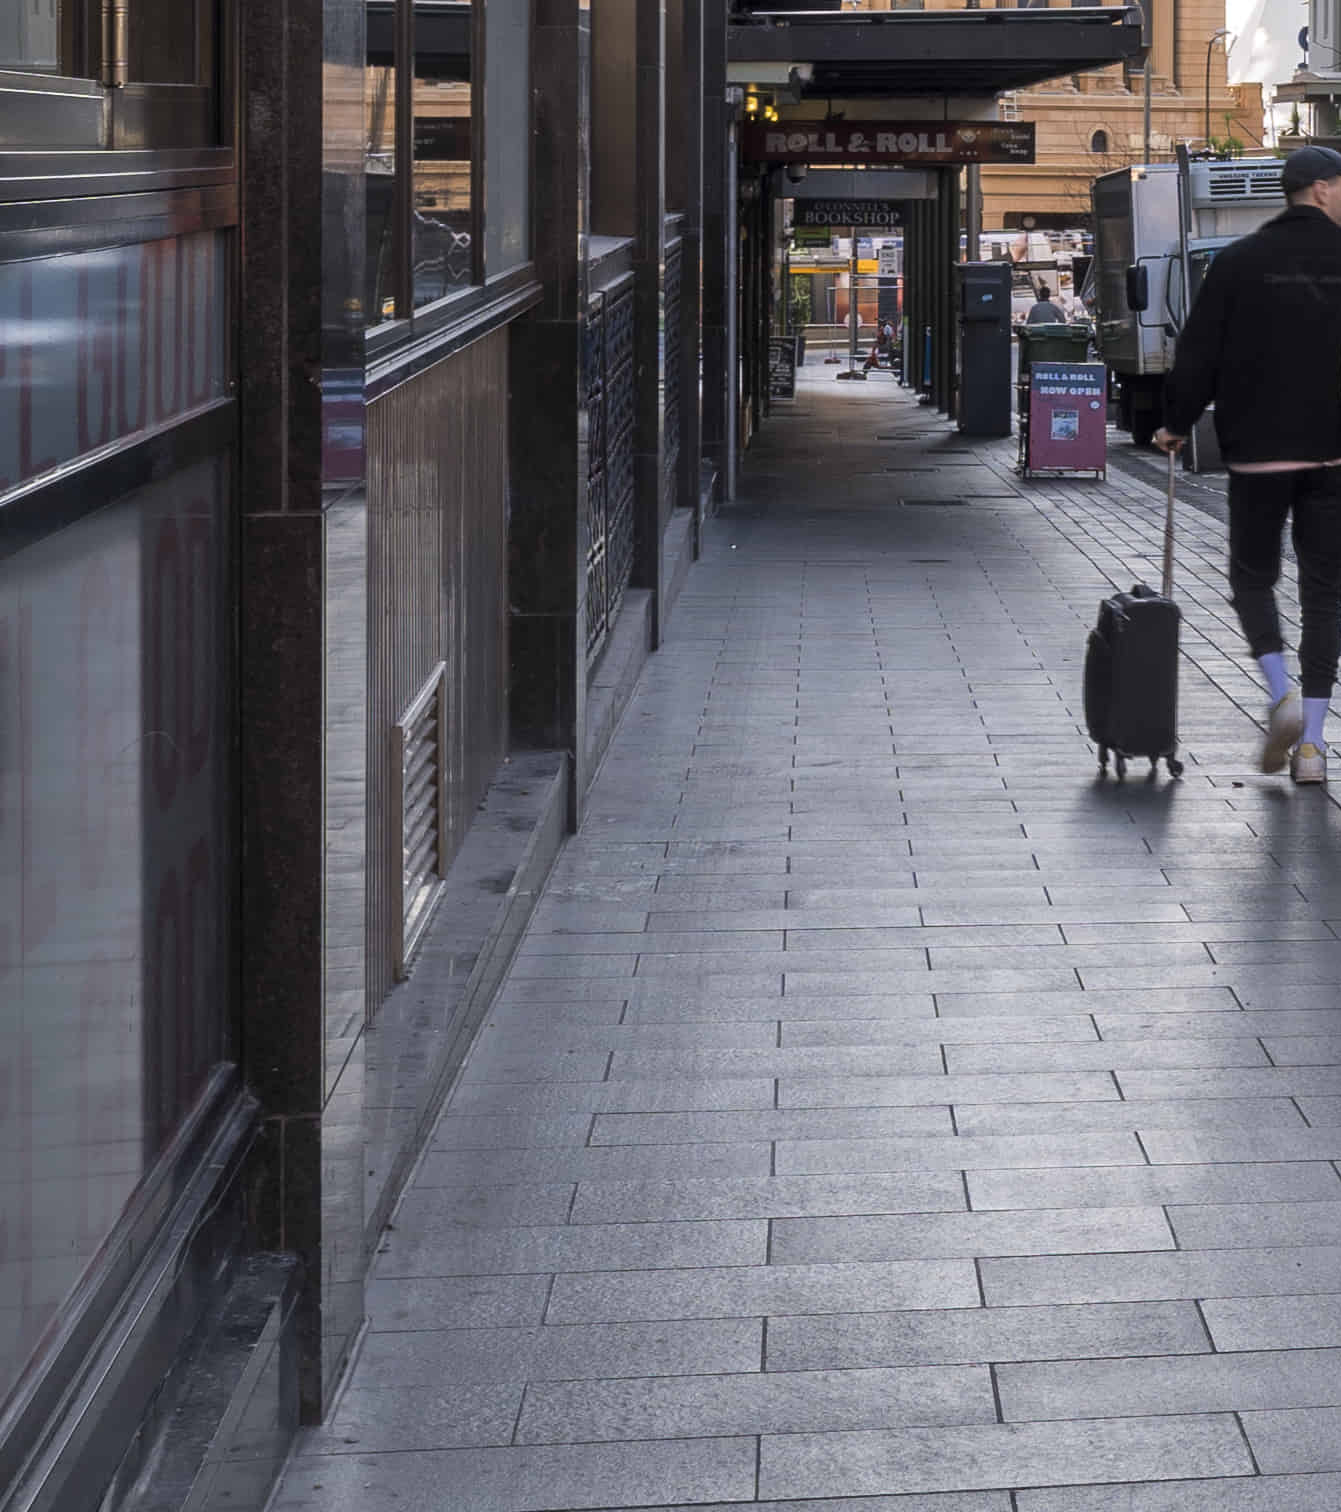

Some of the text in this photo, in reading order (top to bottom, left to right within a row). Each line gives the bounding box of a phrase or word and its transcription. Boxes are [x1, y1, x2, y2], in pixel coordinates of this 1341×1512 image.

[766, 132, 952, 153] ROLL & ROLL
[805, 212, 900, 225] BOOKSHOP
[1040, 386, 1101, 396] NOW OPEN
